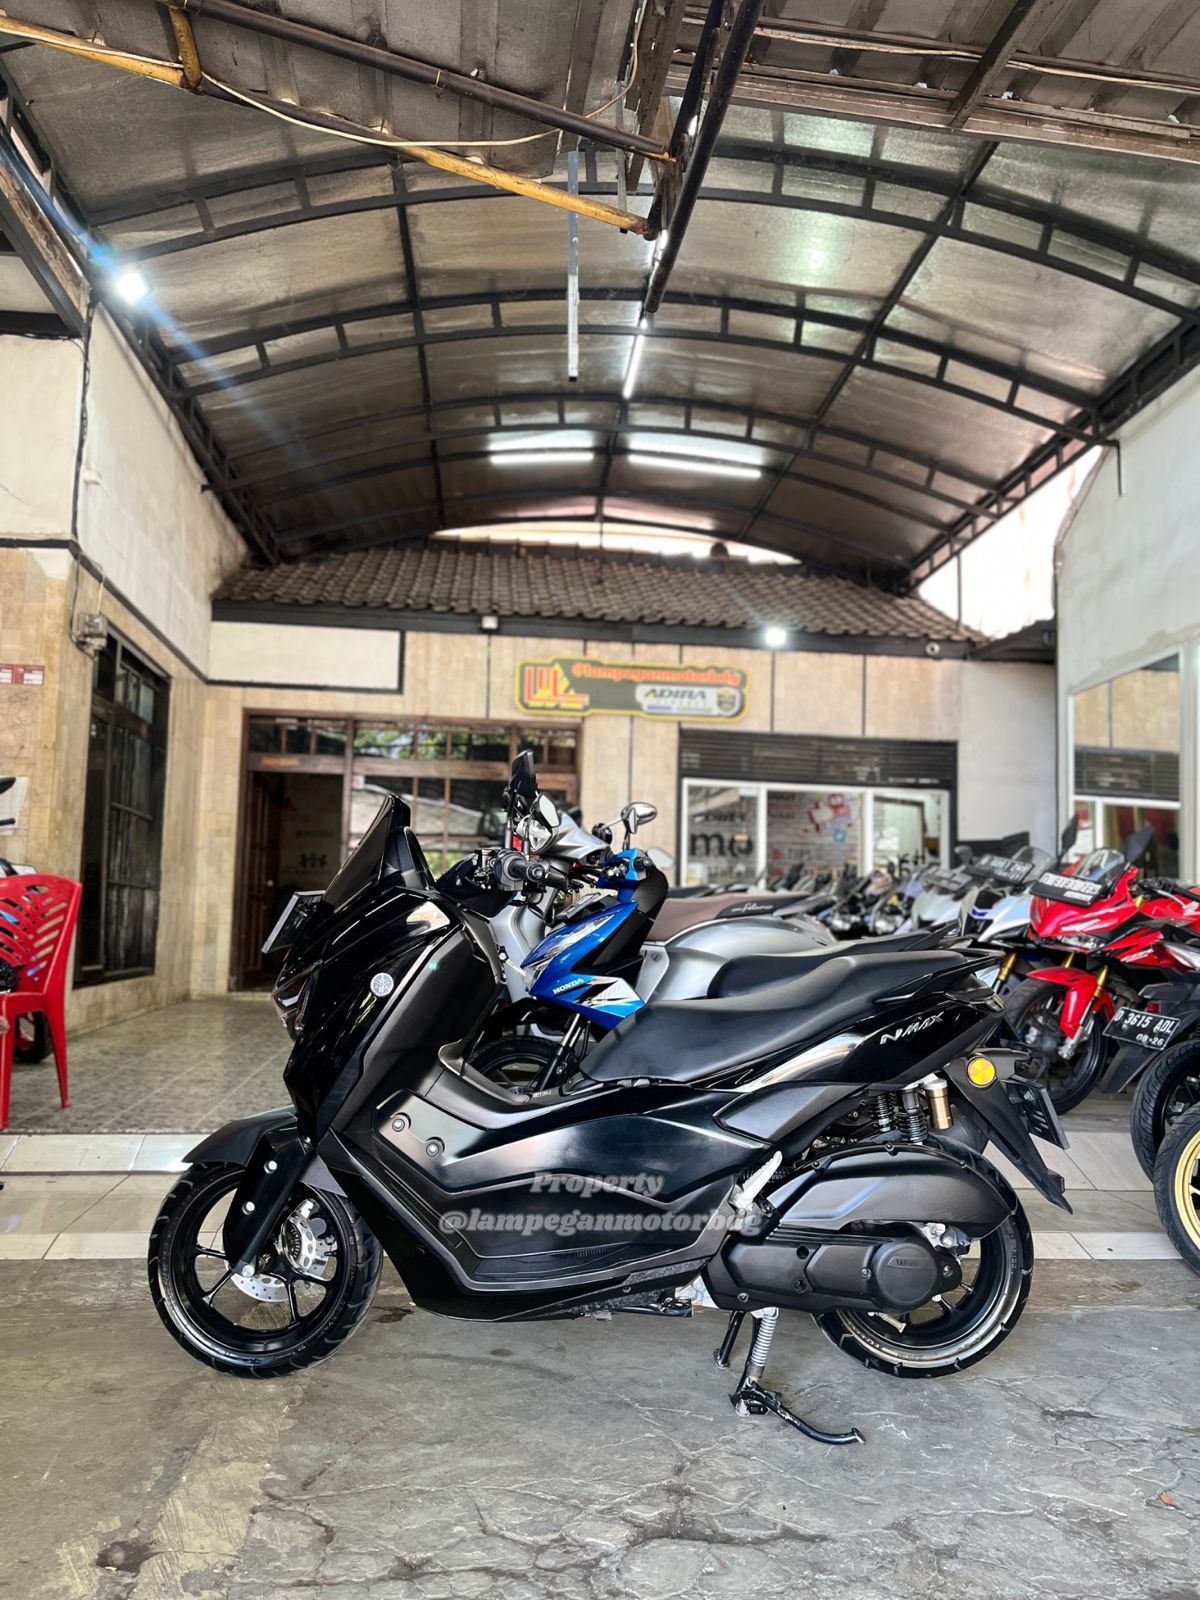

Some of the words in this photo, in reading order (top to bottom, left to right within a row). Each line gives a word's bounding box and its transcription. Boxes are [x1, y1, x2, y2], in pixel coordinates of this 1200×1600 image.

[645, 688, 707, 700] ADIRA
[552, 978, 584, 994] HONDA
[1114, 1010, 1125, 1022] D
[1124, 1012, 1153, 1029] 3615
[1153, 1019, 1175, 1034] ADL
